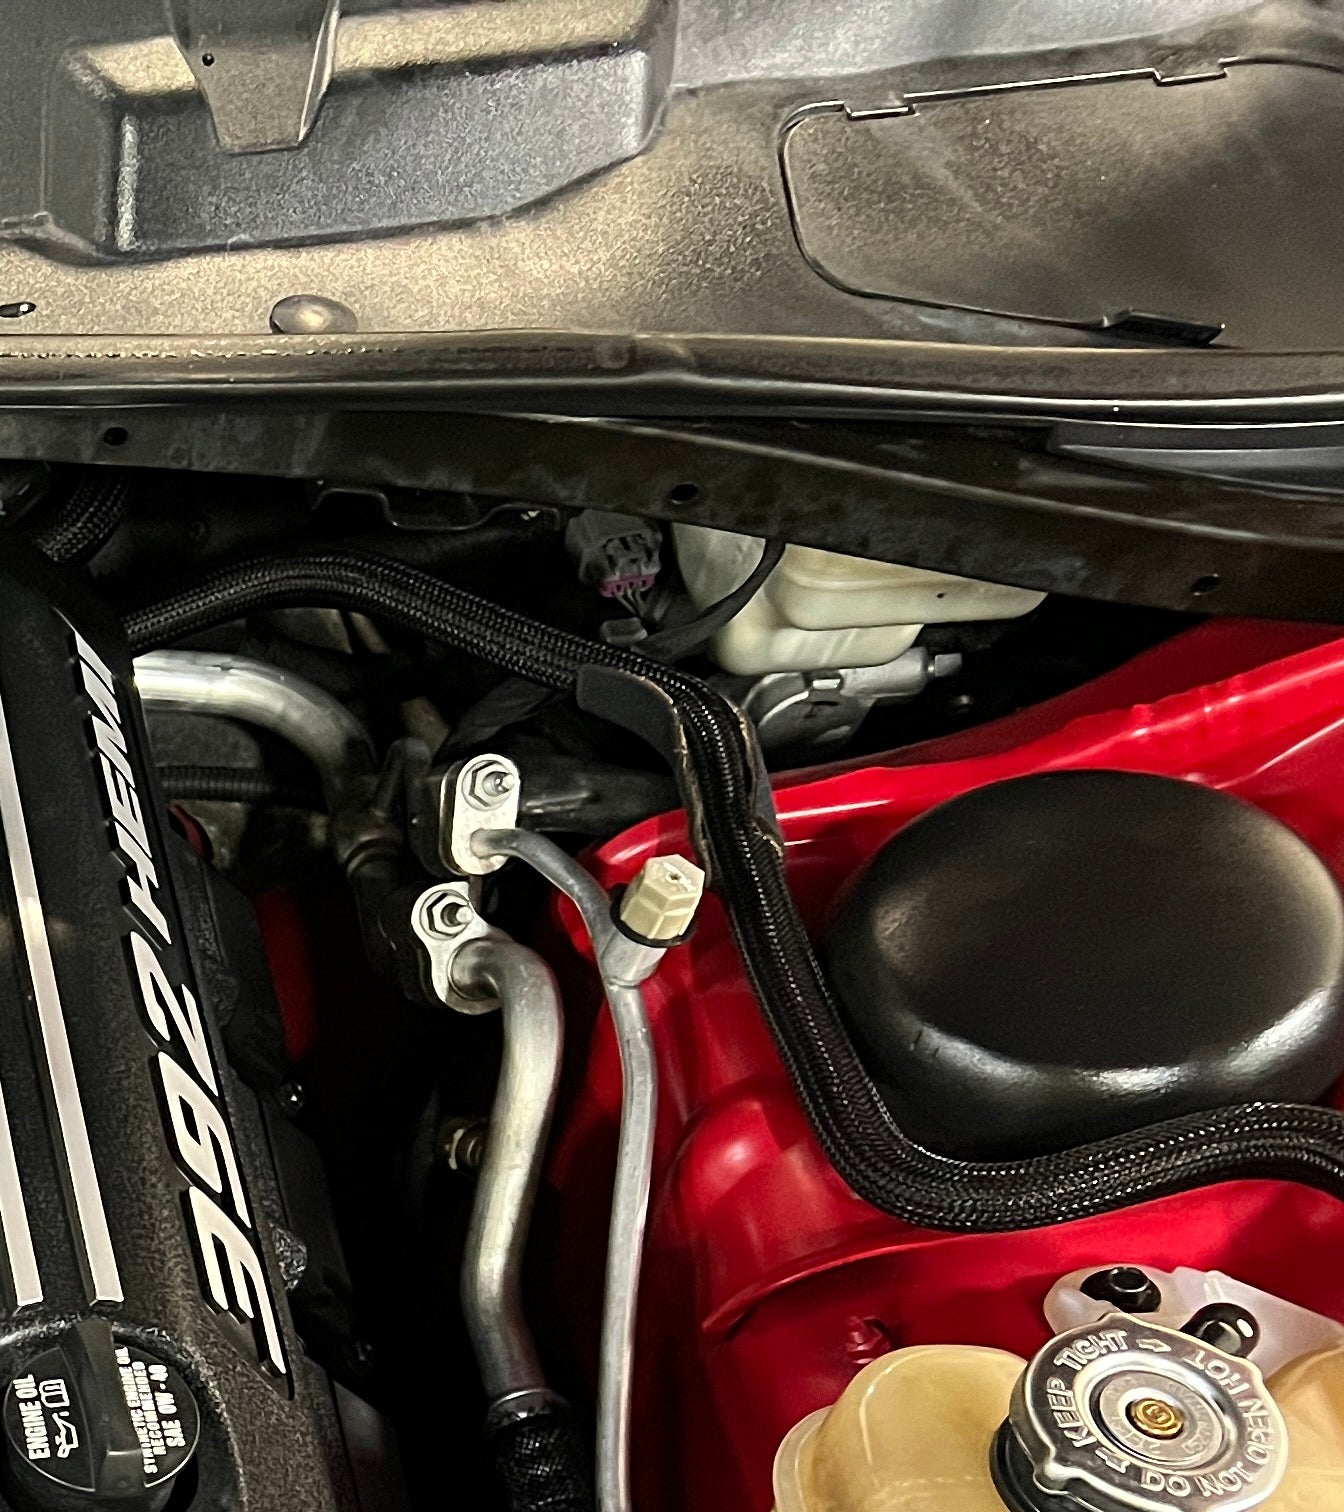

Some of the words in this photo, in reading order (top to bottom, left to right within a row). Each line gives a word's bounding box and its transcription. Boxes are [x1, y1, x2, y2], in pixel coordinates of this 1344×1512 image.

[72, 630, 172, 945] HEMI
[129, 931, 286, 1375] 392
[114, 1346, 131, 1365] OIL
[1053, 1328, 1129, 1372] TIGHT
[1183, 1350, 1251, 1396] HOT
[12, 1374, 39, 1399] OIL
[118, 1366, 141, 1408] ENGINE
[131, 1361, 167, 1456] RECOMMENDED
[17, 1400, 51, 1460] ENGINE
[160, 1419, 187, 1447] SAE
[1046, 1376, 1098, 1448] KEEP
[1243, 1398, 1276, 1467] OPEN
[130, 1408, 158, 1474] SYNTHETIC
[1140, 1469, 1192, 1498] DO
[1196, 1459, 1255, 1499] NOT
